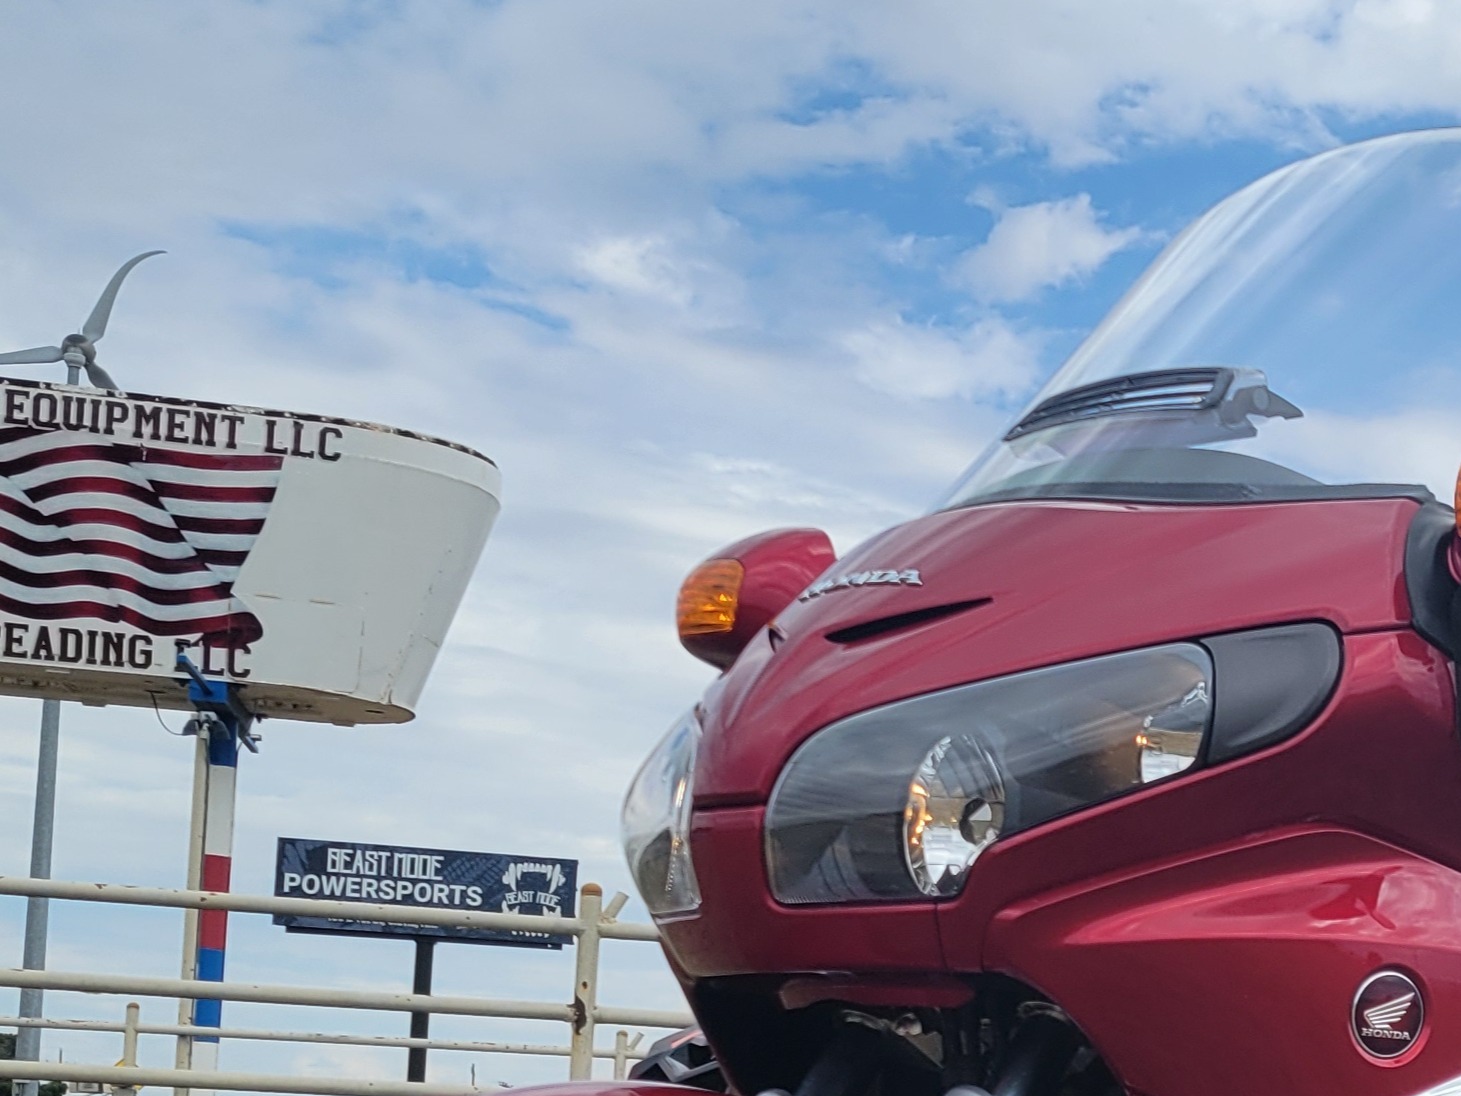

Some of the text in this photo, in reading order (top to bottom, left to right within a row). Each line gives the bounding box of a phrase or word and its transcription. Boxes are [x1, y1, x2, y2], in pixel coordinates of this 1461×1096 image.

[4, 388, 343, 463] EQUIPMENT LLC
[0, 621, 153, 670] EADING
[326, 847, 445, 881] BEAST MODE
[282, 872, 484, 907] POWERSPORTS
[1361, 1027, 1412, 1041] HONDA
